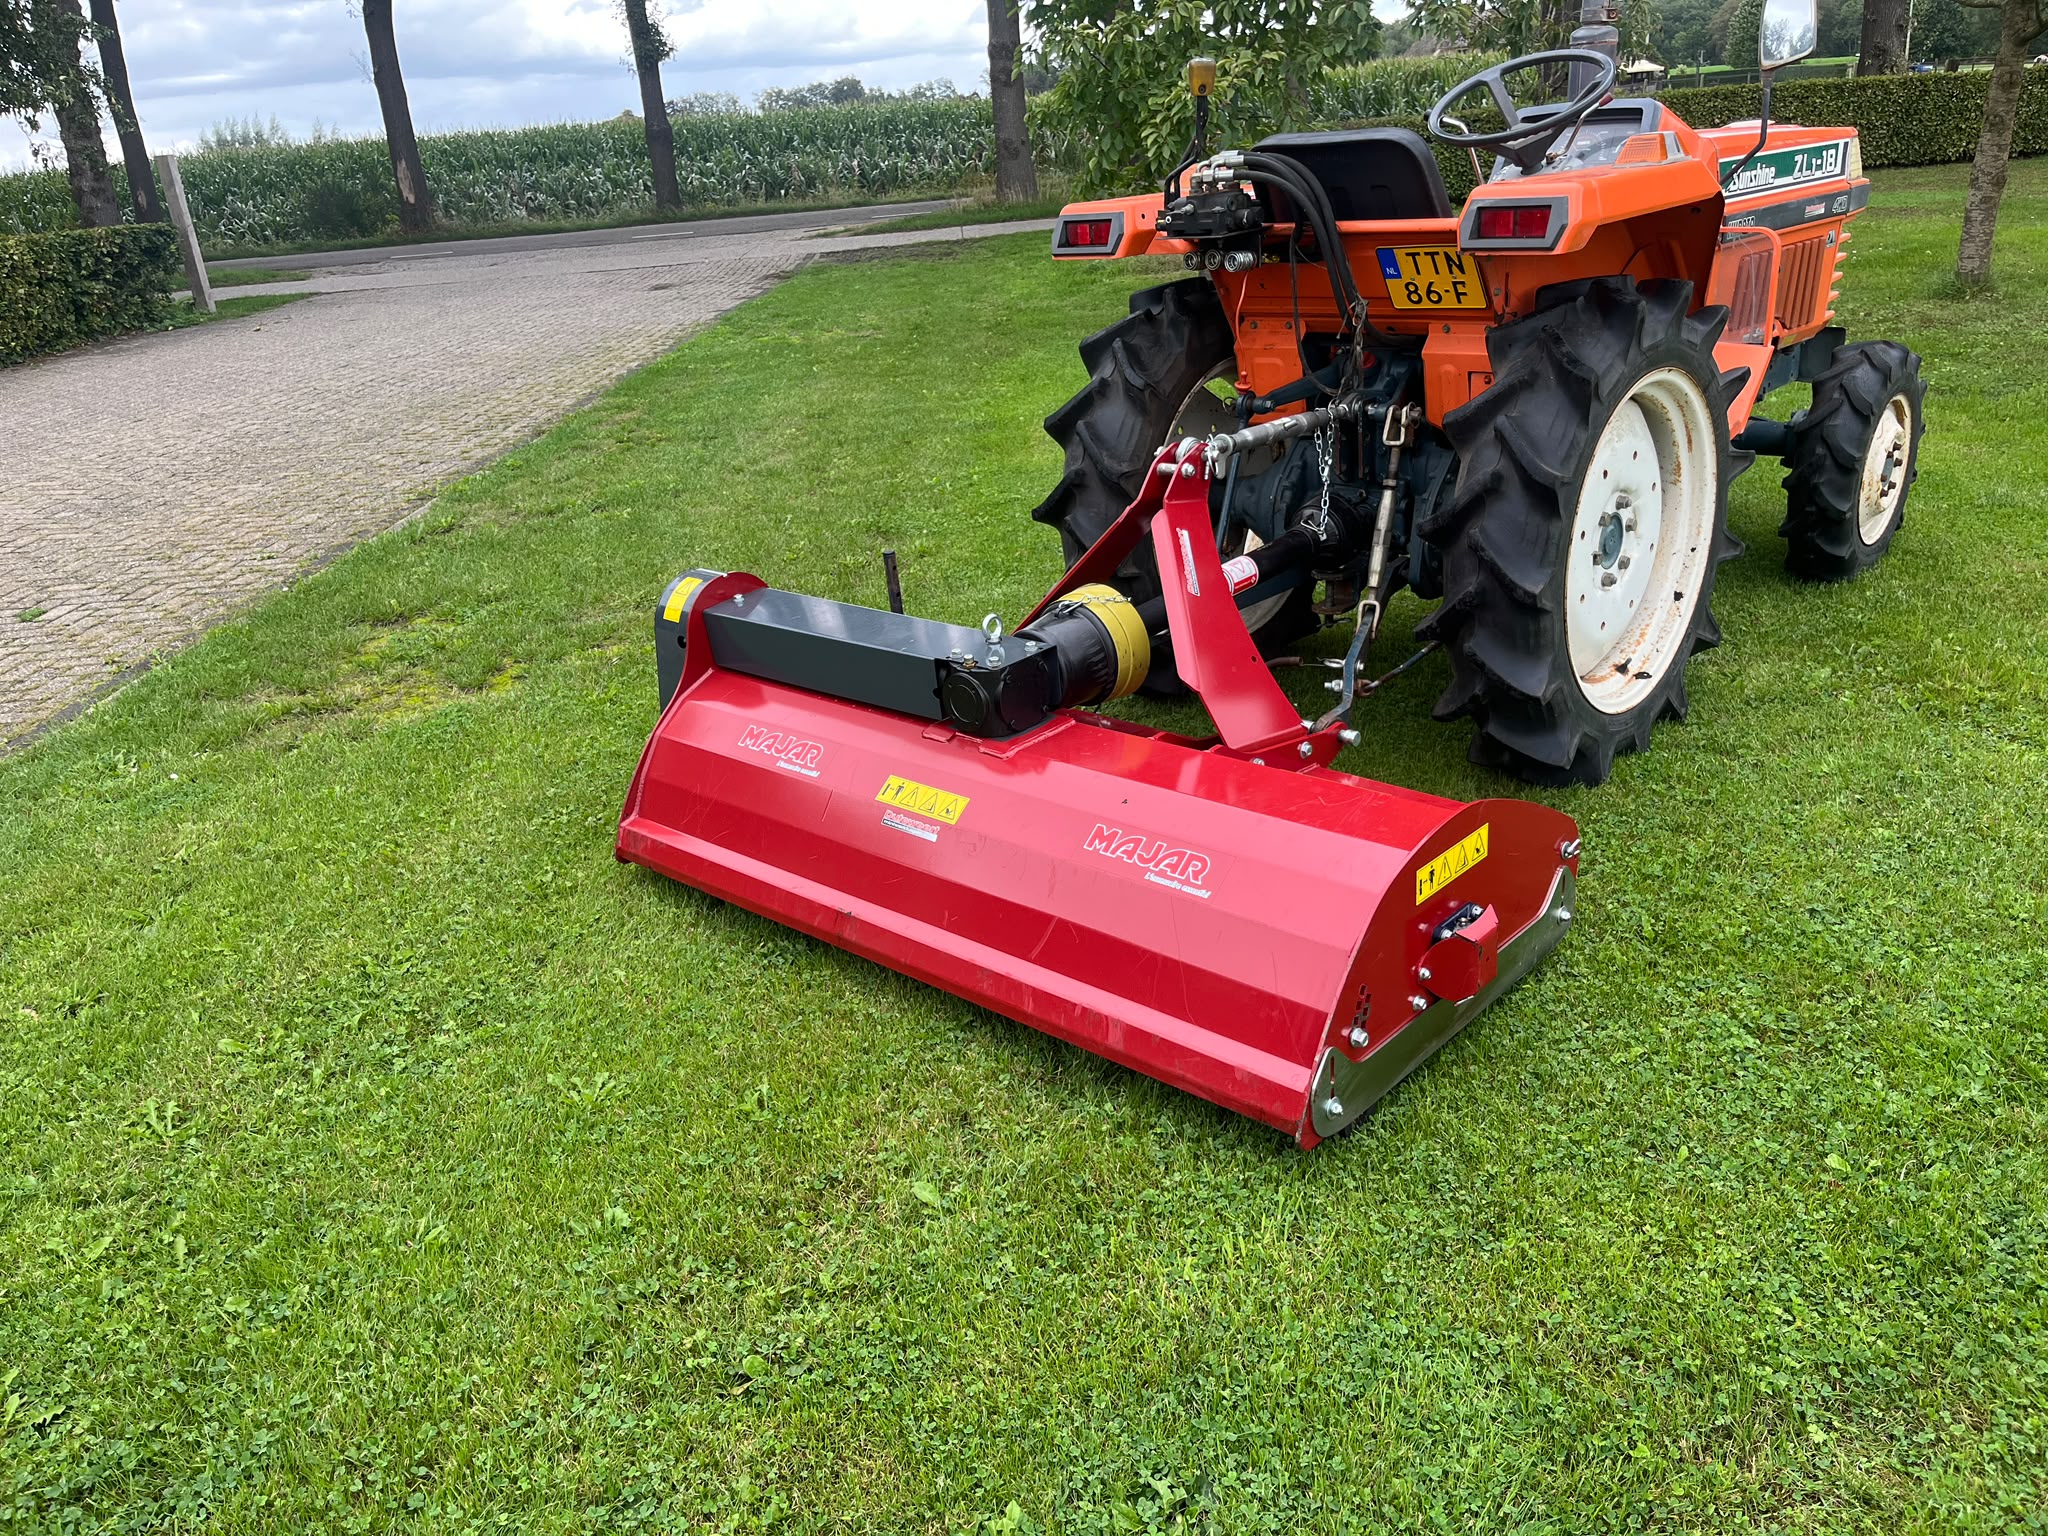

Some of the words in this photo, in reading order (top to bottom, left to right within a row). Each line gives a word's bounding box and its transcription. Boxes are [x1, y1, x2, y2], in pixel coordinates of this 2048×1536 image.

[1727, 162, 1776, 192] Sunshine
[1386, 267, 1398, 275] NL
[1405, 250, 1466, 275] TTN
[1404, 281, 1468, 305] 86-F
[737, 724, 824, 768] MAJAR
[1083, 823, 1210, 885] MAJAR
